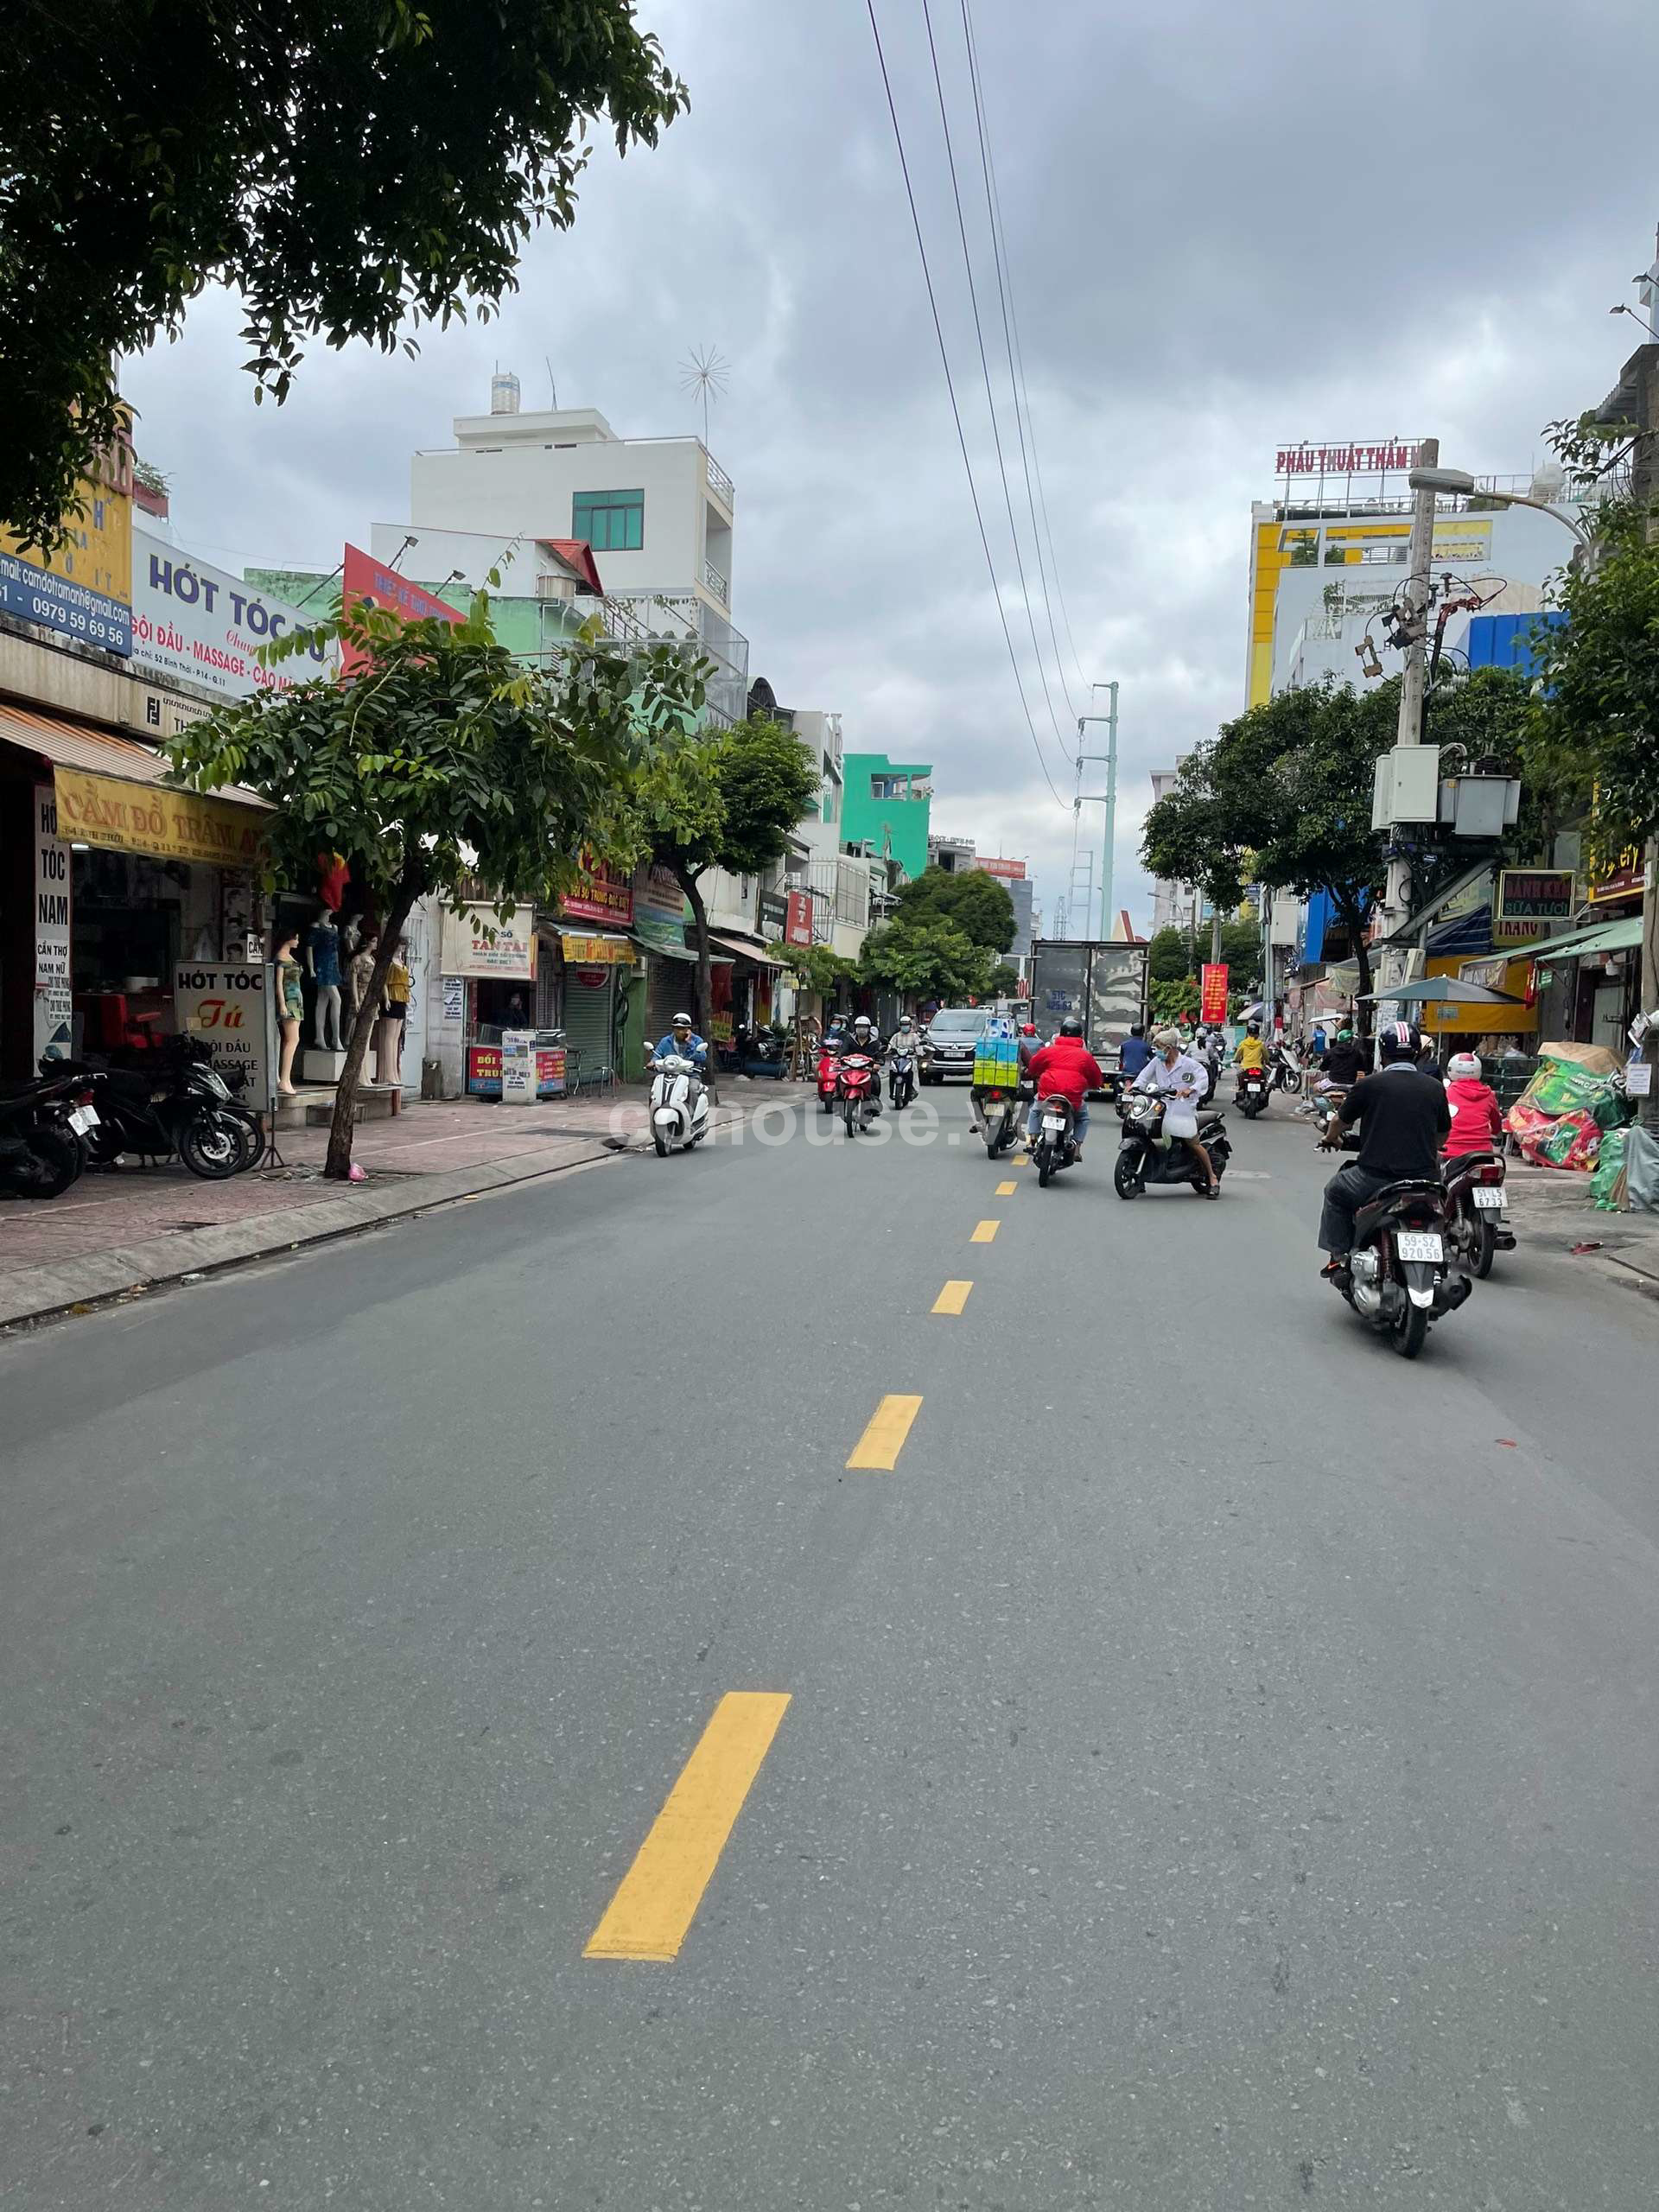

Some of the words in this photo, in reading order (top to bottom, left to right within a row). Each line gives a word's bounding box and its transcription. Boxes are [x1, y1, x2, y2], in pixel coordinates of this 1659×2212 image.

[22, 568, 130, 626] camdotramanh@gmail.com
[149, 554, 219, 613] HỚT
[32, 596, 67, 624] 0979
[69, 611, 86, 631] 59
[89, 620, 105, 639] 69
[108, 626, 124, 645] 56
[155, 653, 163, 664] 52
[157, 620, 183, 653] ĐẦU
[194, 640, 245, 677] MASSAGE
[41, 844, 65, 880] TÓC
[38, 893, 68, 926] NAM
[1505, 900, 1534, 915] SỮA
[1538, 900, 1568, 915] TƯƠI
[53, 944, 68, 958] THỢ
[38, 962, 54, 975] NAM
[178, 969, 219, 990] HỚT
[223, 969, 263, 991] TÓC
[198, 999, 245, 1028] Tú
[1402, 1247, 1440, 1260] 920.56
